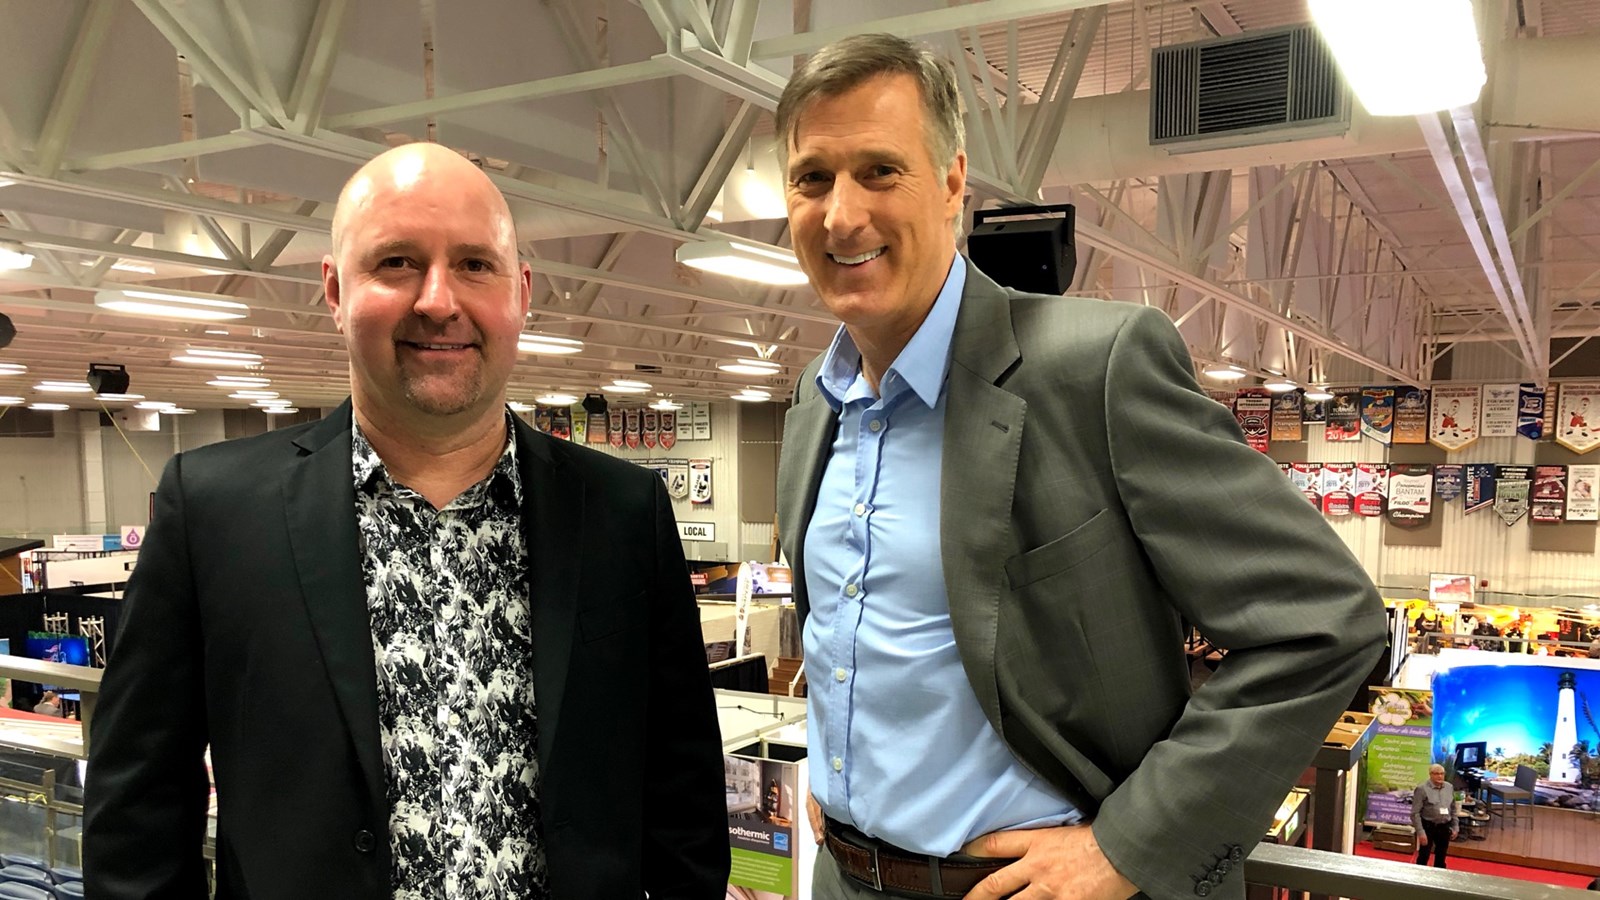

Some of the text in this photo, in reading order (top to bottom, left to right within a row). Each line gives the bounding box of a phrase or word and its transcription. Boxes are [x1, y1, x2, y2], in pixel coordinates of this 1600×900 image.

[1466, 466, 1474, 500] FINALISTE
[684, 526, 706, 536] LOCAL
[728, 826, 770, 840] sothermic
